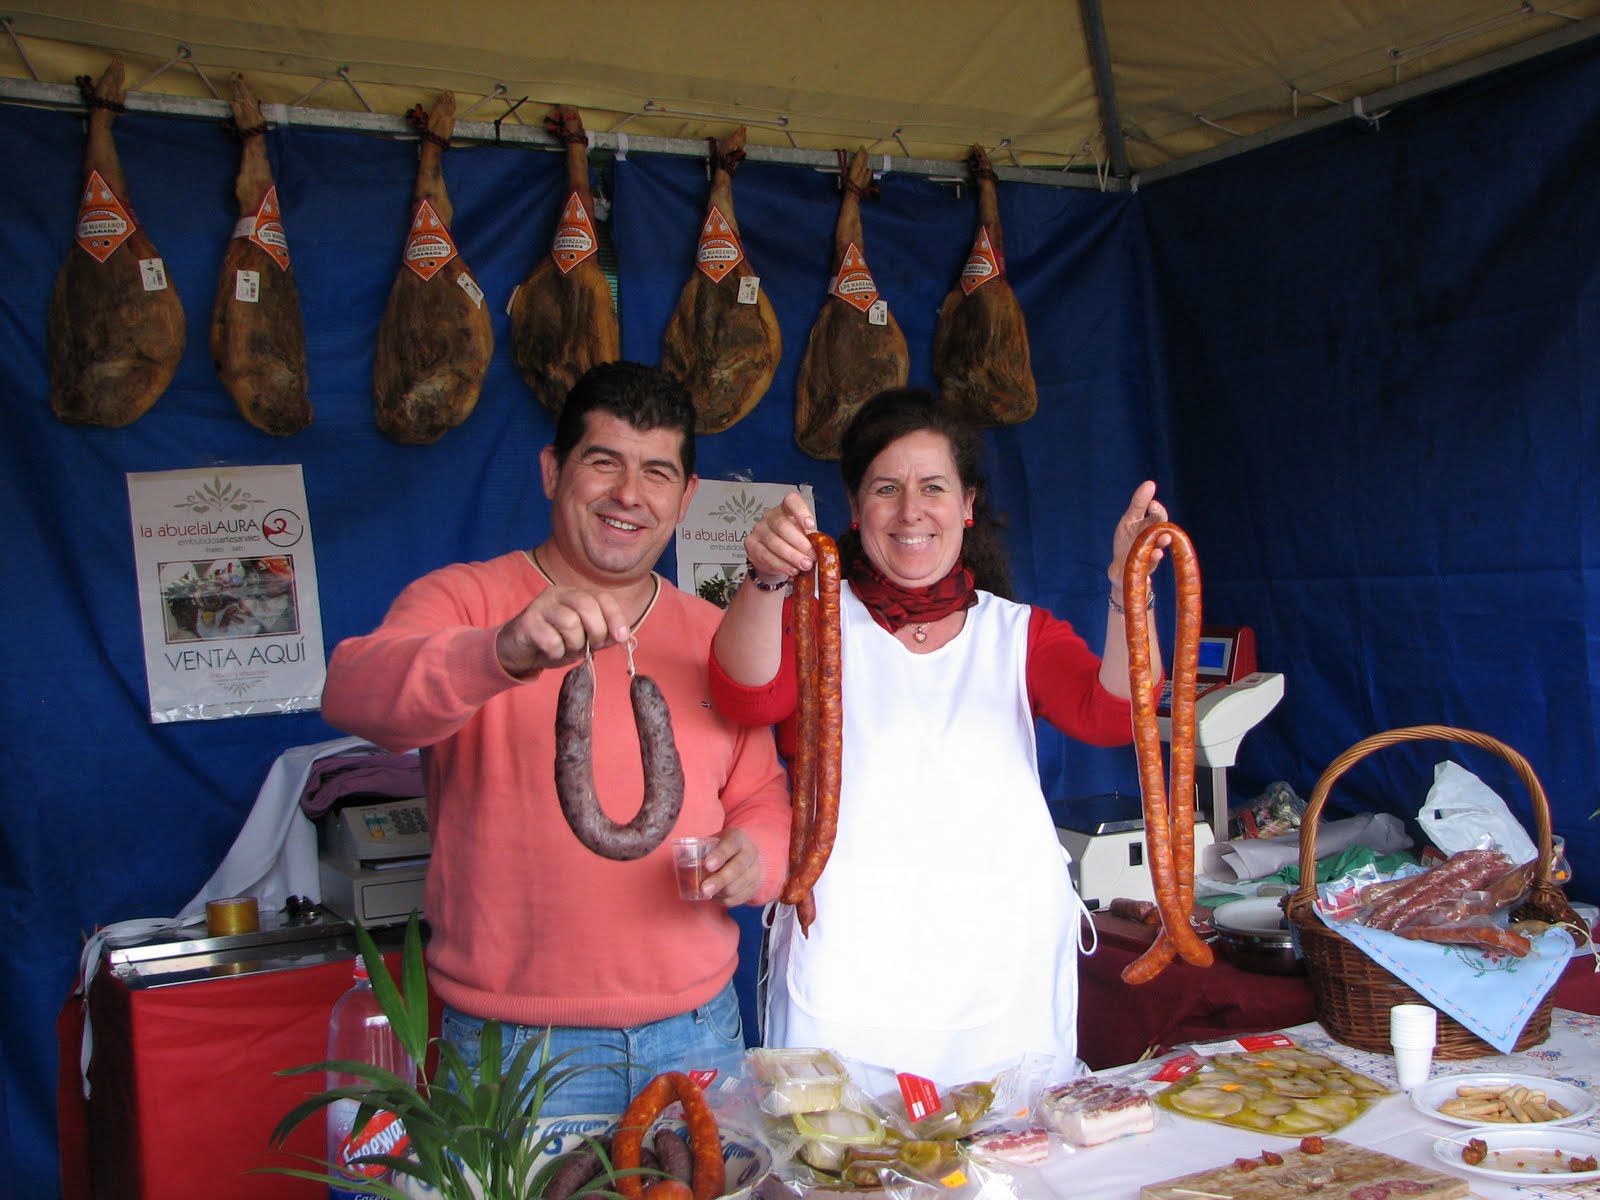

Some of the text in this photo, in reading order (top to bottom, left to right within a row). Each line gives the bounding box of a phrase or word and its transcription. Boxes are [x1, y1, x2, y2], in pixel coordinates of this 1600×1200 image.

[140, 523, 153, 538] la
[682, 527, 691, 540] la
[165, 636, 306, 672] VENTA AQUÍ
